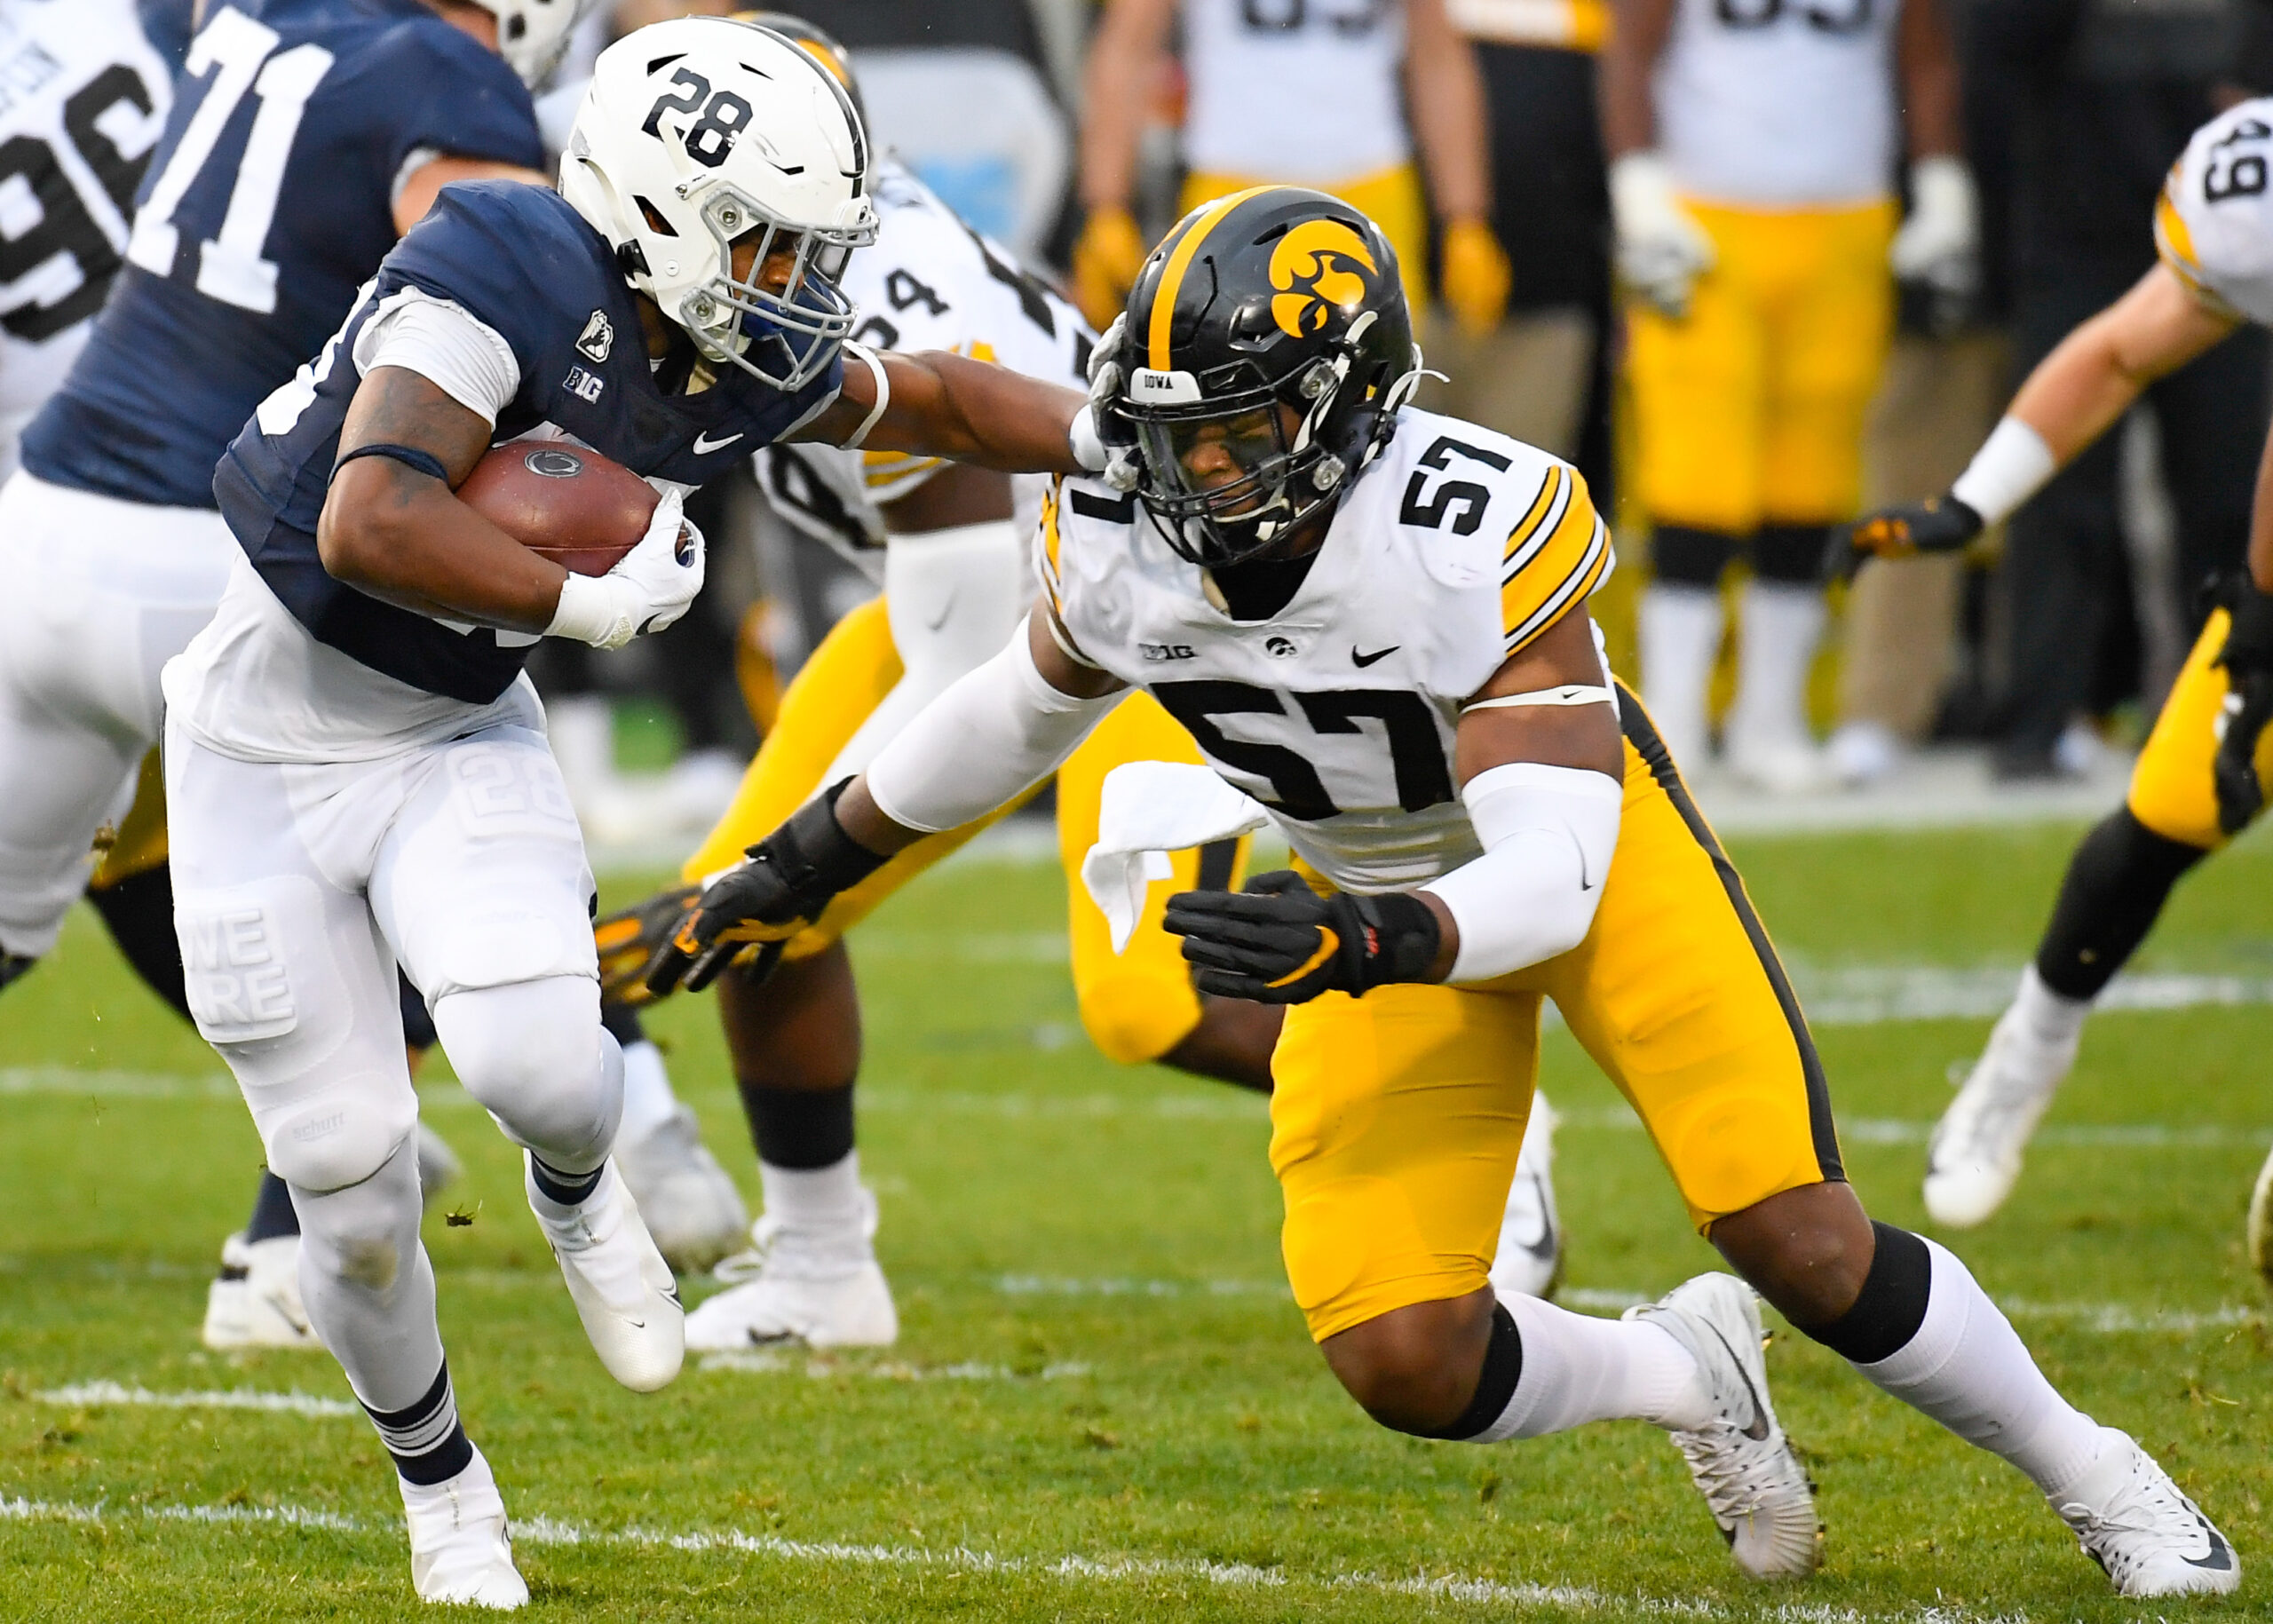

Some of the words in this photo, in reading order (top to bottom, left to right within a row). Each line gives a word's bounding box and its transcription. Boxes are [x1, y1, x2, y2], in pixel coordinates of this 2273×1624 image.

[185, 5, 335, 313] 71
[641, 67, 753, 168] 28
[0, 62, 156, 343] 96
[1144, 374, 1174, 390] IOWA
[1399, 435, 1513, 536] 57
[457, 755, 577, 823] 28
[1149, 680, 1454, 821] 57
